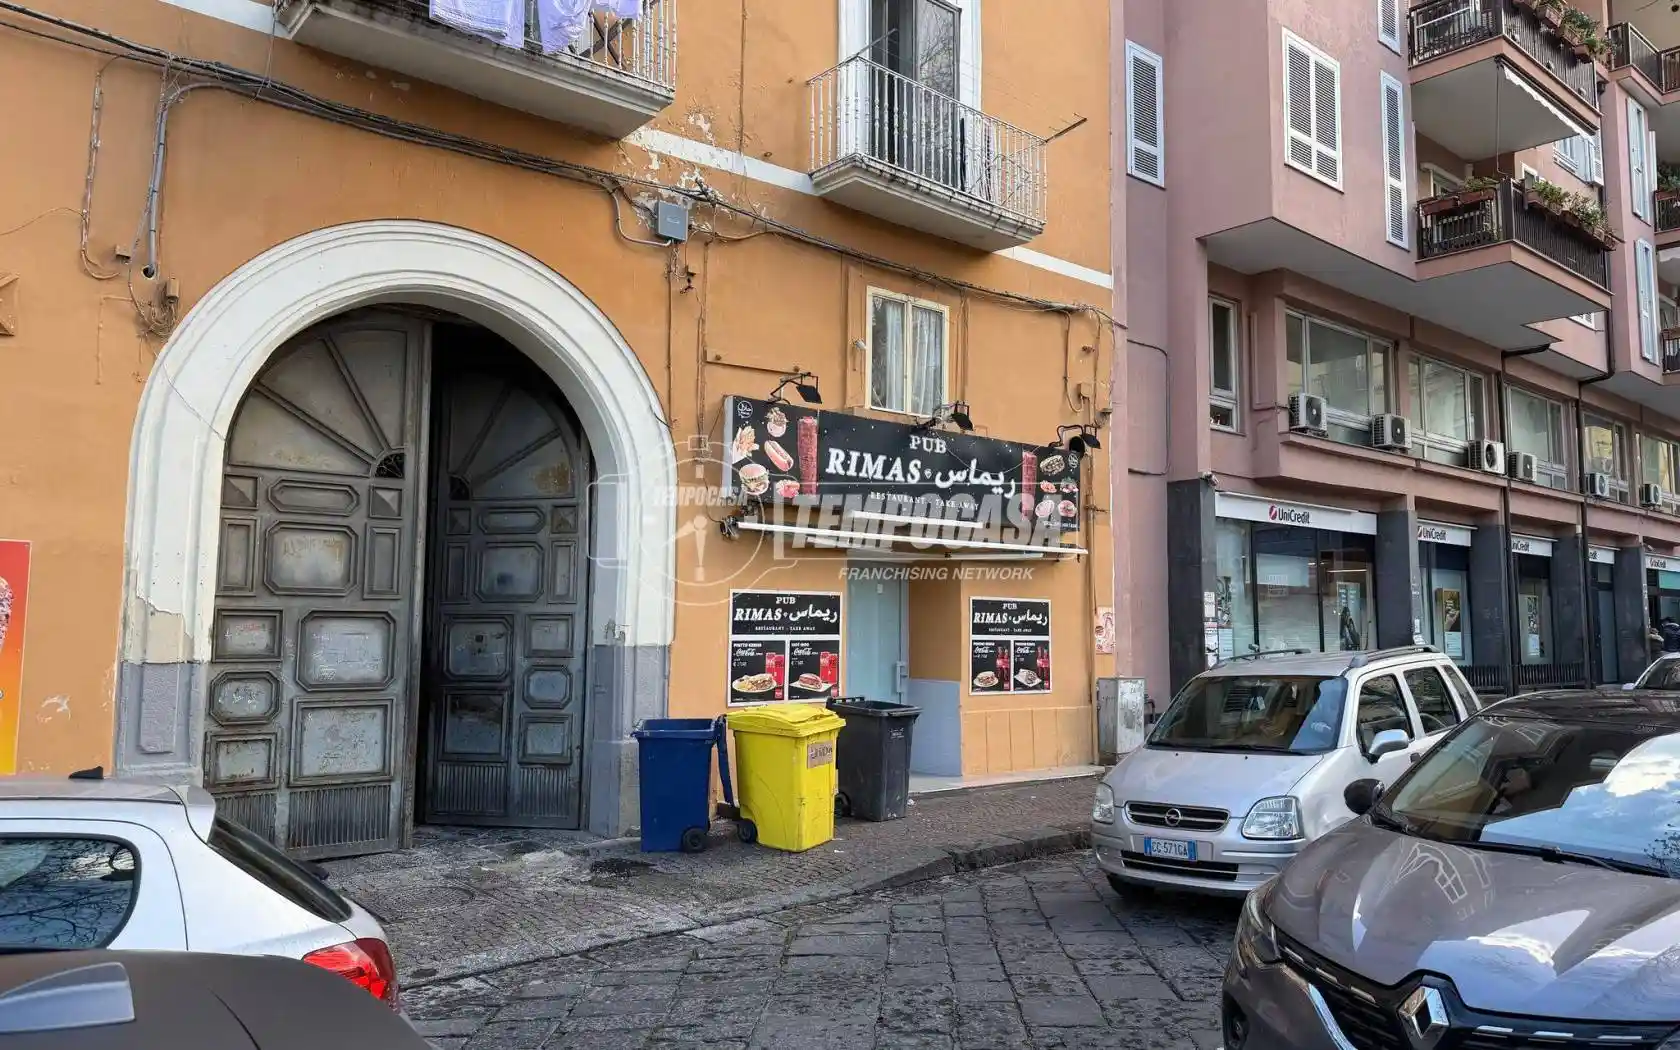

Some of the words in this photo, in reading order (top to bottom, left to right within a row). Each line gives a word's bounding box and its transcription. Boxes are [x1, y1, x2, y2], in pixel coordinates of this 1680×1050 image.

[909, 434, 947, 454] PUB
[825, 447, 922, 485] RIMAS
[934, 459, 1017, 499] ريماس
[870, 491, 926, 504] RESTAURANT
[1278, 507, 1310, 524] UniCredit
[1423, 526, 1447, 541] UniCredit
[775, 596, 796, 604] PUB
[734, 607, 783, 621] RIMAS
[788, 604, 838, 623] ريماس
[973, 612, 1008, 624] RIMAS
[1012, 609, 1048, 626] ريماس
